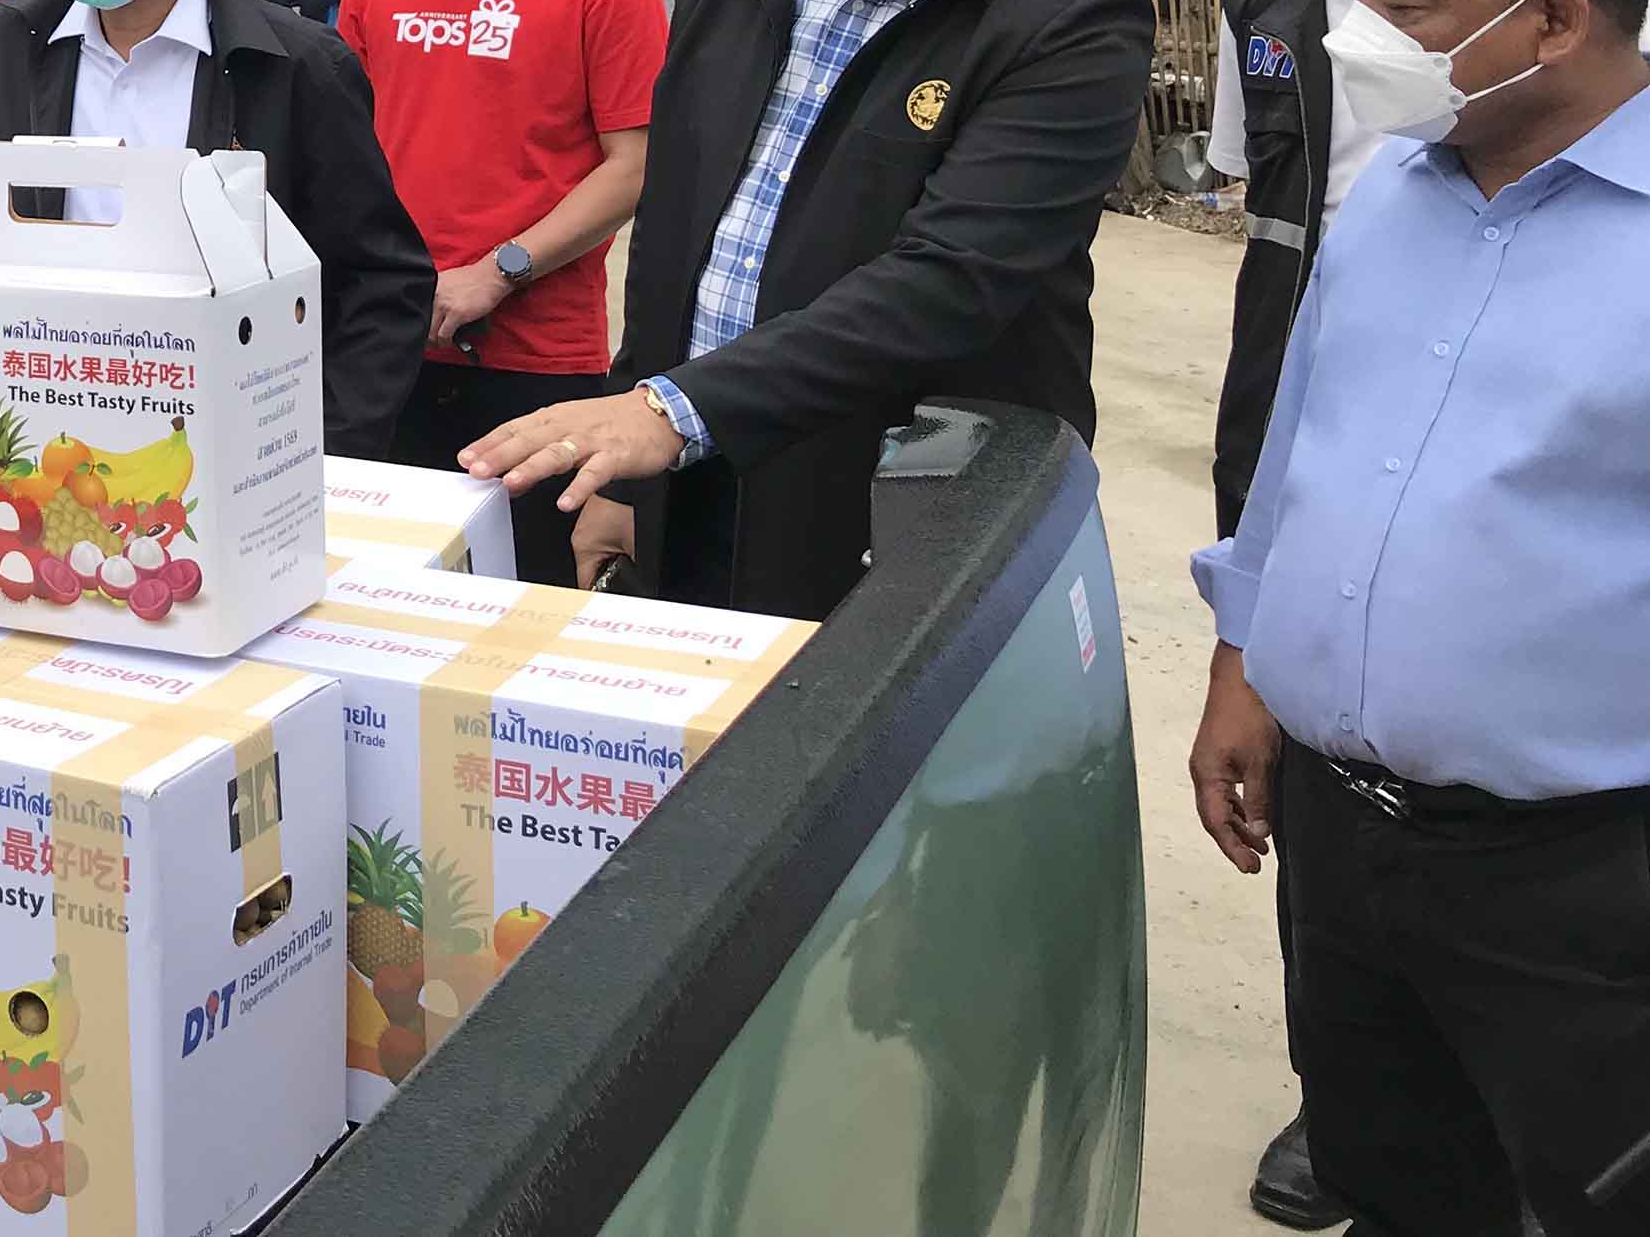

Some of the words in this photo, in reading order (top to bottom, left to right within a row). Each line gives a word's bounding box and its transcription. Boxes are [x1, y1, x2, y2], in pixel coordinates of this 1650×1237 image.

[392, 12, 466, 53] Tops
[472, 20, 510, 52] 25
[3, 350, 196, 390] 泰国水果最好吃!
[8, 385, 40, 403] The
[45, 388, 84, 407] Best
[88, 391, 136, 415] Tasty
[141, 396, 195, 415] Fruits
[353, 730, 386, 749] Trade
[454, 752, 657, 822] 泰国水果最
[461, 803, 513, 834] The
[521, 813, 583, 848] Best
[51, 892, 130, 934] Fruits
[240, 910, 333, 995] กรมการค้าภายใน
[239, 975, 280, 1015] Department
[280, 968, 288, 984] of
[289, 951, 314, 977] Internal
[315, 936, 333, 956] Trade
